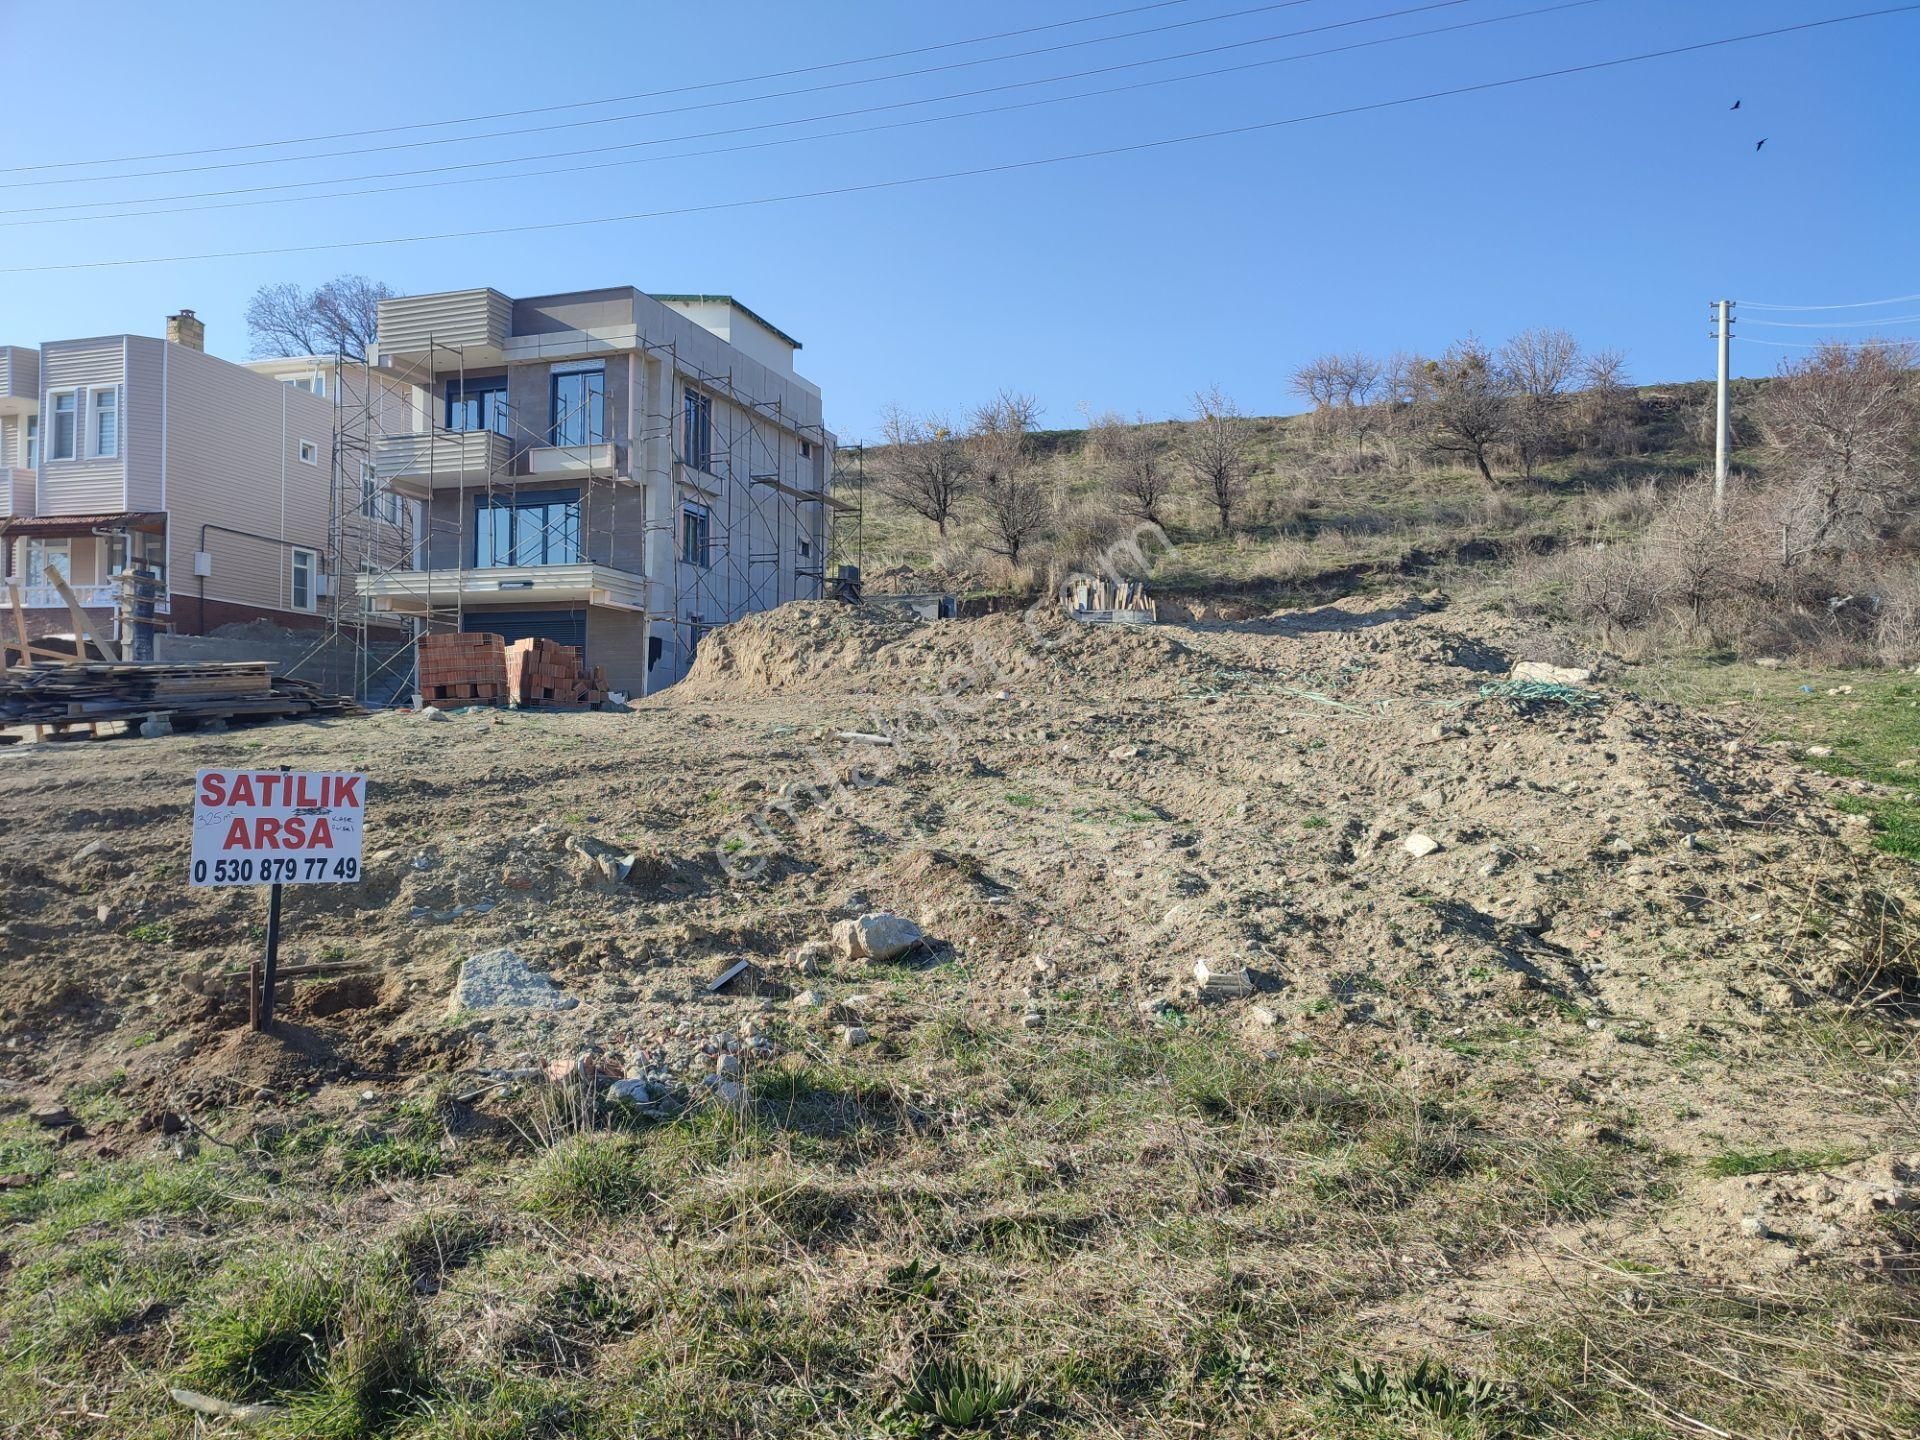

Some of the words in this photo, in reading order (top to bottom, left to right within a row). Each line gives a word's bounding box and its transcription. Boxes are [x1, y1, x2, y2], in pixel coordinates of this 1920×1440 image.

[200, 773, 360, 807] SATILIK
[222, 817, 334, 850] ARSA
[194, 859, 207, 882] 0
[214, 859, 253, 882] 530
[259, 858, 297, 881] 879
[304, 857, 328, 880] 77
[333, 857, 357, 879] 49
